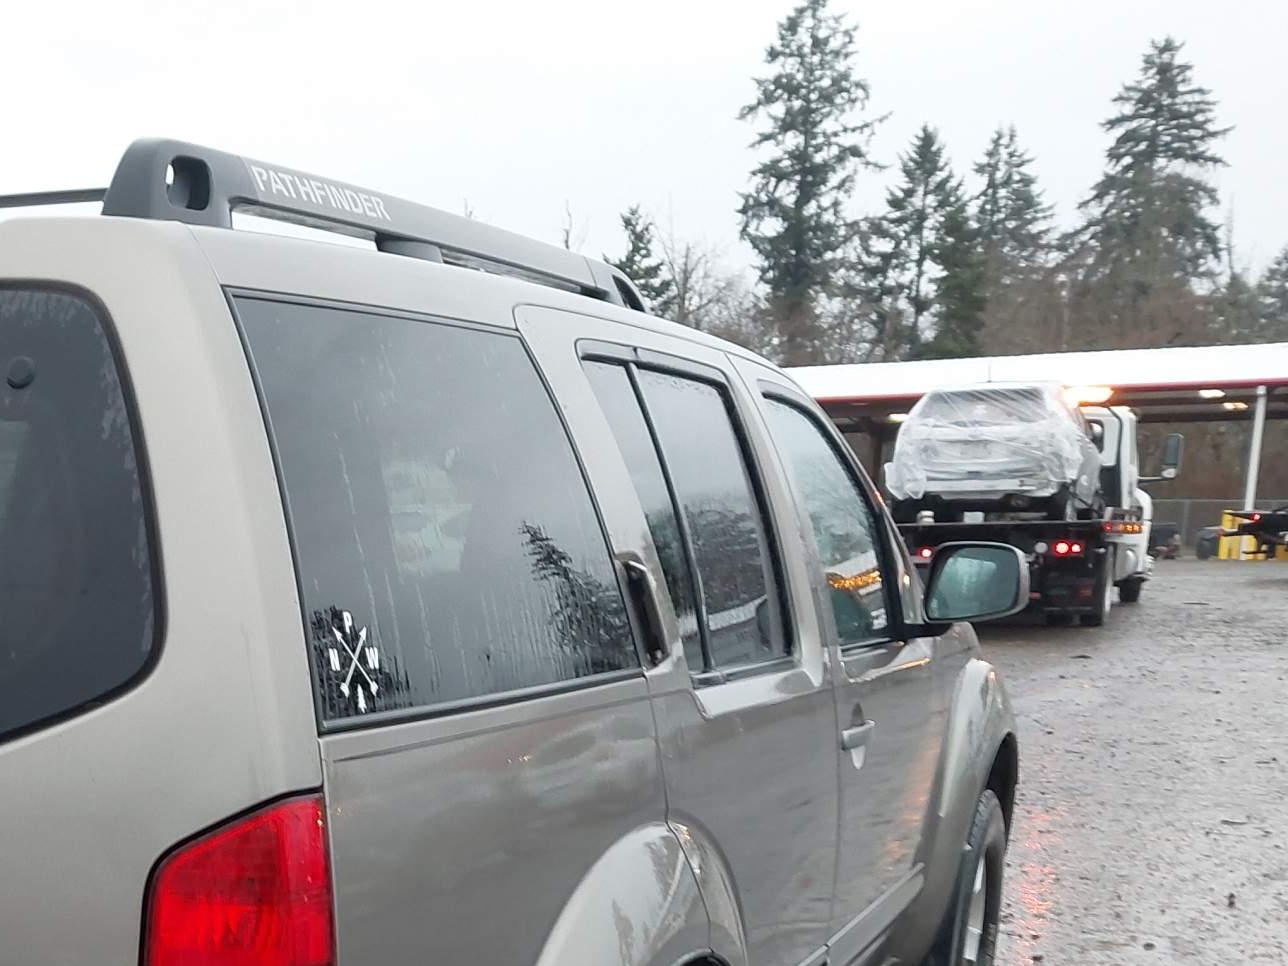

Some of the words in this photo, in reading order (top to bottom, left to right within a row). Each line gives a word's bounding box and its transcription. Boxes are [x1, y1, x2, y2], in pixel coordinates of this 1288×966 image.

[250, 165, 392, 222] PATHFINDER
[342, 611, 353, 634] P
[365, 646, 380, 670] W
